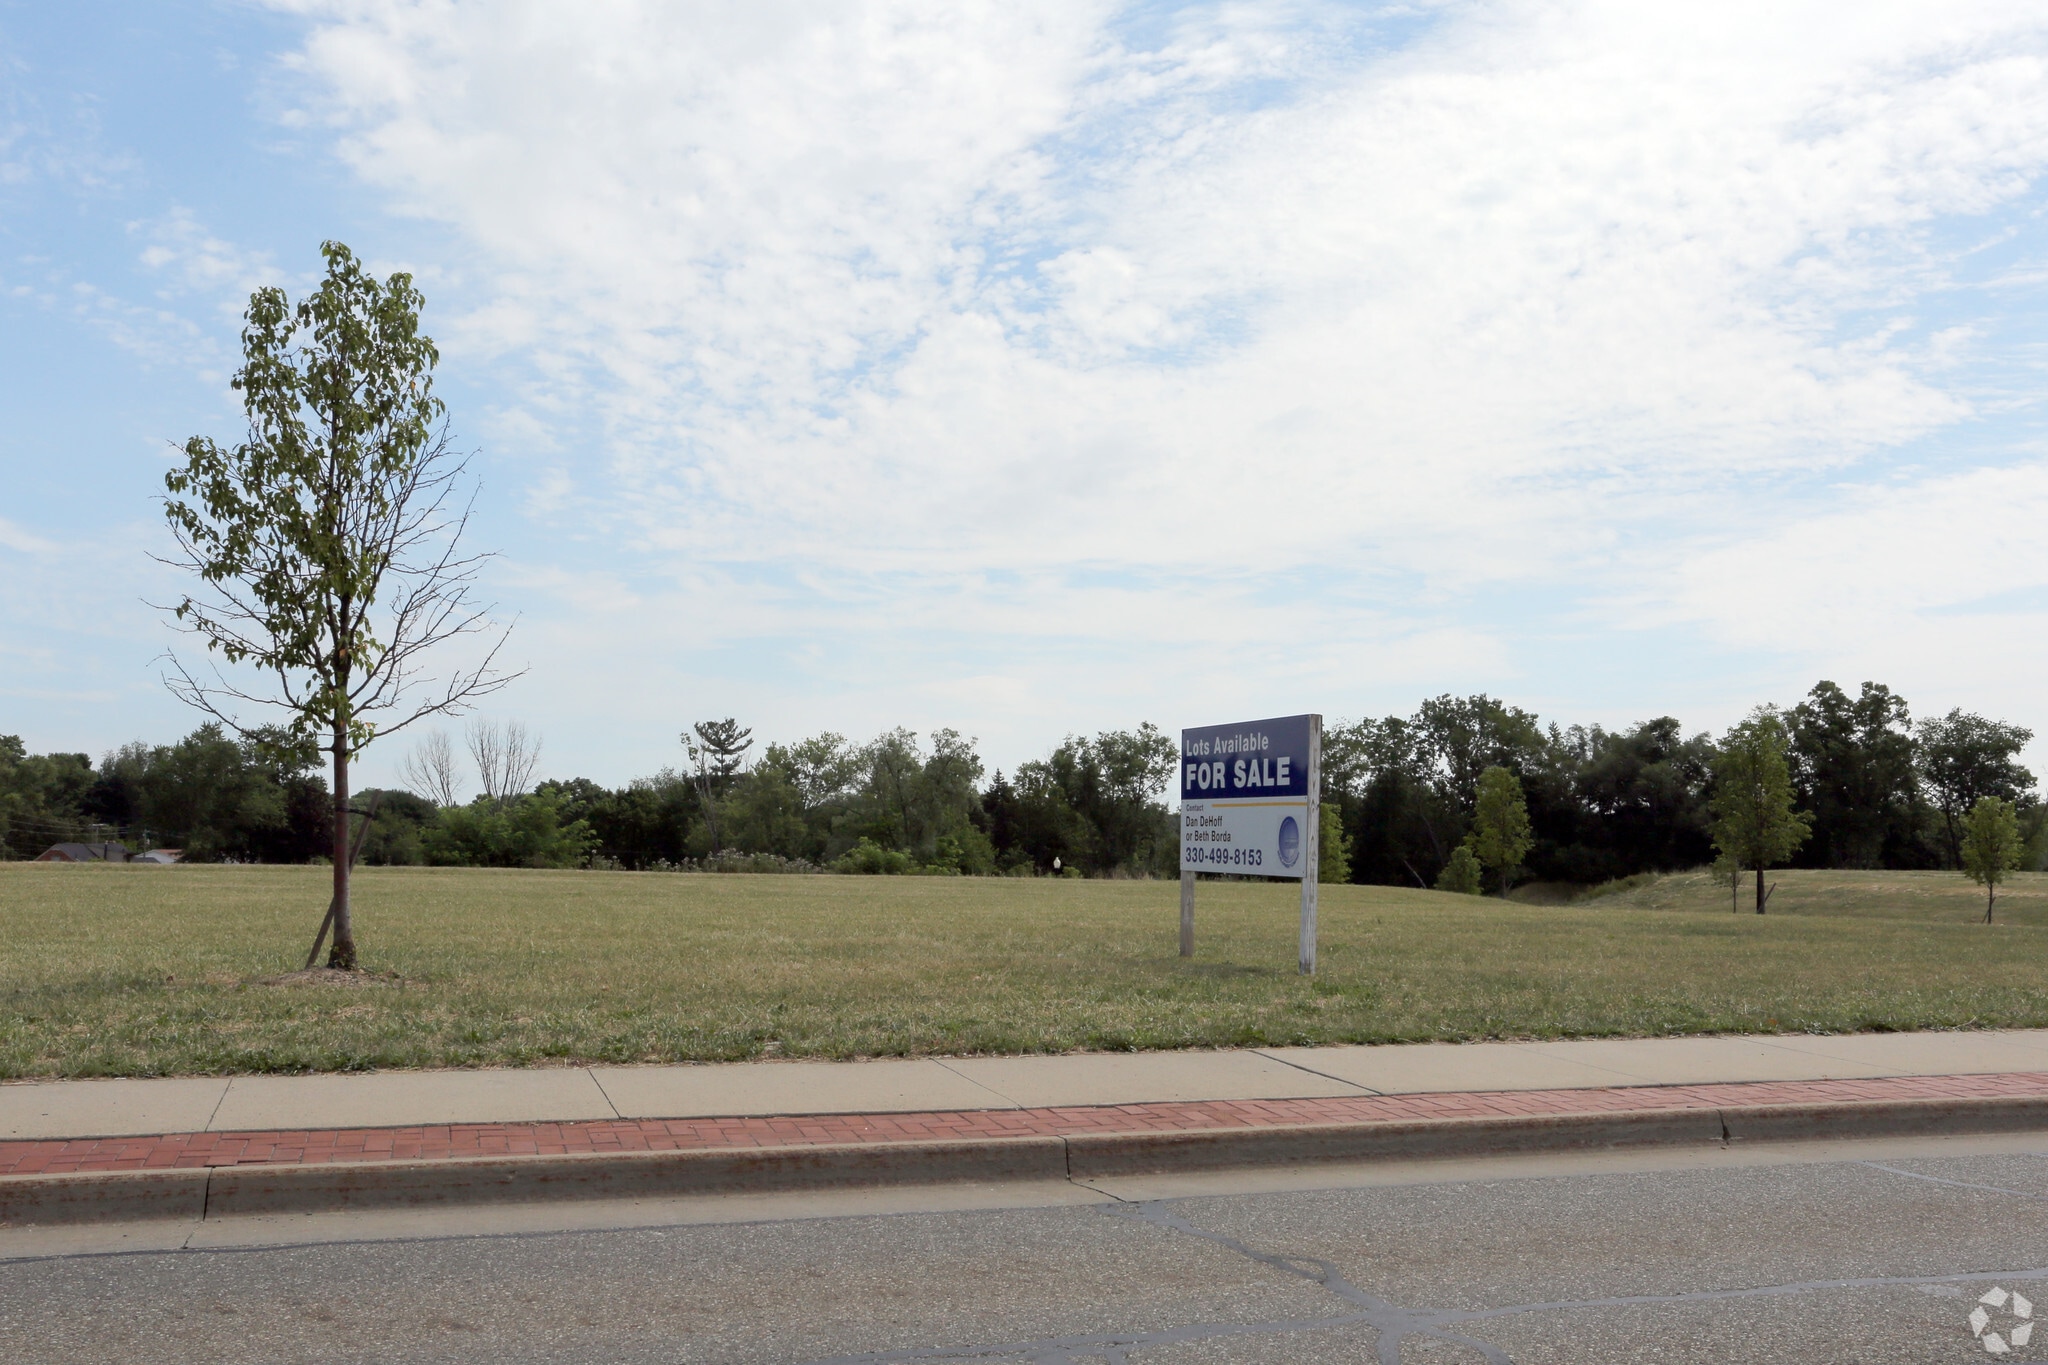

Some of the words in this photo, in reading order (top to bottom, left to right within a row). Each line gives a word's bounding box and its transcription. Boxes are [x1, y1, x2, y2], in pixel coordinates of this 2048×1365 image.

[1186, 740, 1209, 757] Lots
[1213, 732, 1269, 754] Available
[1186, 762, 1226, 790] FOR
[1233, 756, 1291, 789] SALE
[1186, 804, 1204, 812] Contact
[1186, 816, 1198, 827] Dan
[1200, 815, 1223, 827] DeHoff
[1186, 832, 1193, 842] or
[1194, 830, 1209, 842] Beth
[1211, 830, 1231, 842] Borda
[1185, 847, 1262, 866] 330-499-8153
